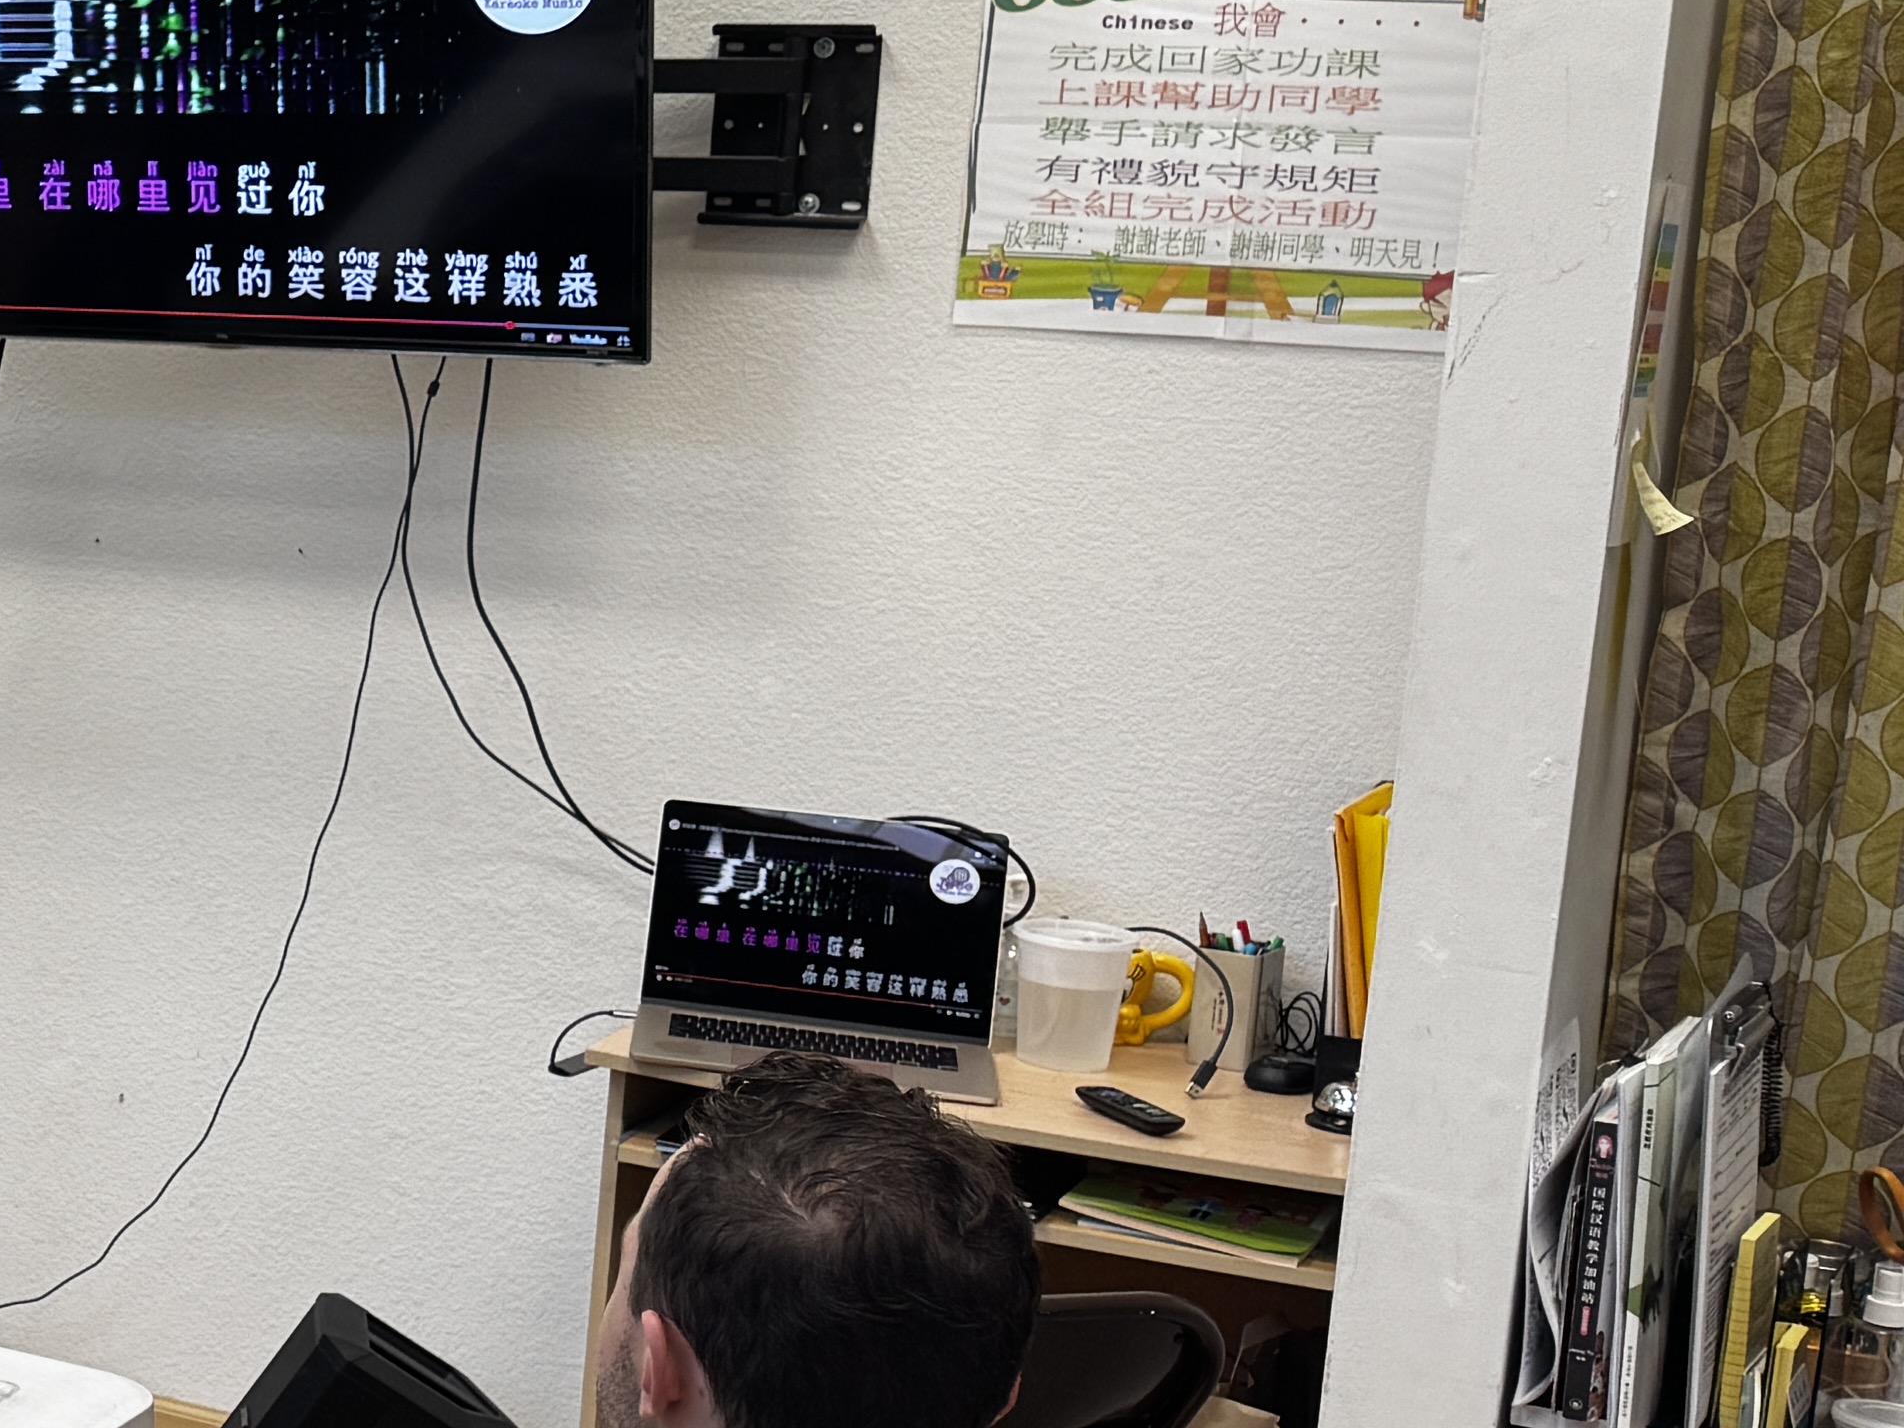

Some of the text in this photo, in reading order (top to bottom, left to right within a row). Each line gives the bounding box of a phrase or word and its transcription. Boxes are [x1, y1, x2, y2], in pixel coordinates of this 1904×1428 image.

[1102, 13, 1194, 31] Chinese
[1048, 43, 1382, 79] 完成回家功課
[1037, 78, 1383, 117] 上課幫助同學
[1039, 116, 1384, 157] 舉手請求發言
[1035, 155, 1382, 195] 有禮貌守規矩
[1029, 188, 1378, 231] 全組完成活動
[243, 244, 265, 263] de
[185, 262, 599, 309] 你的笑容这样熟悉
